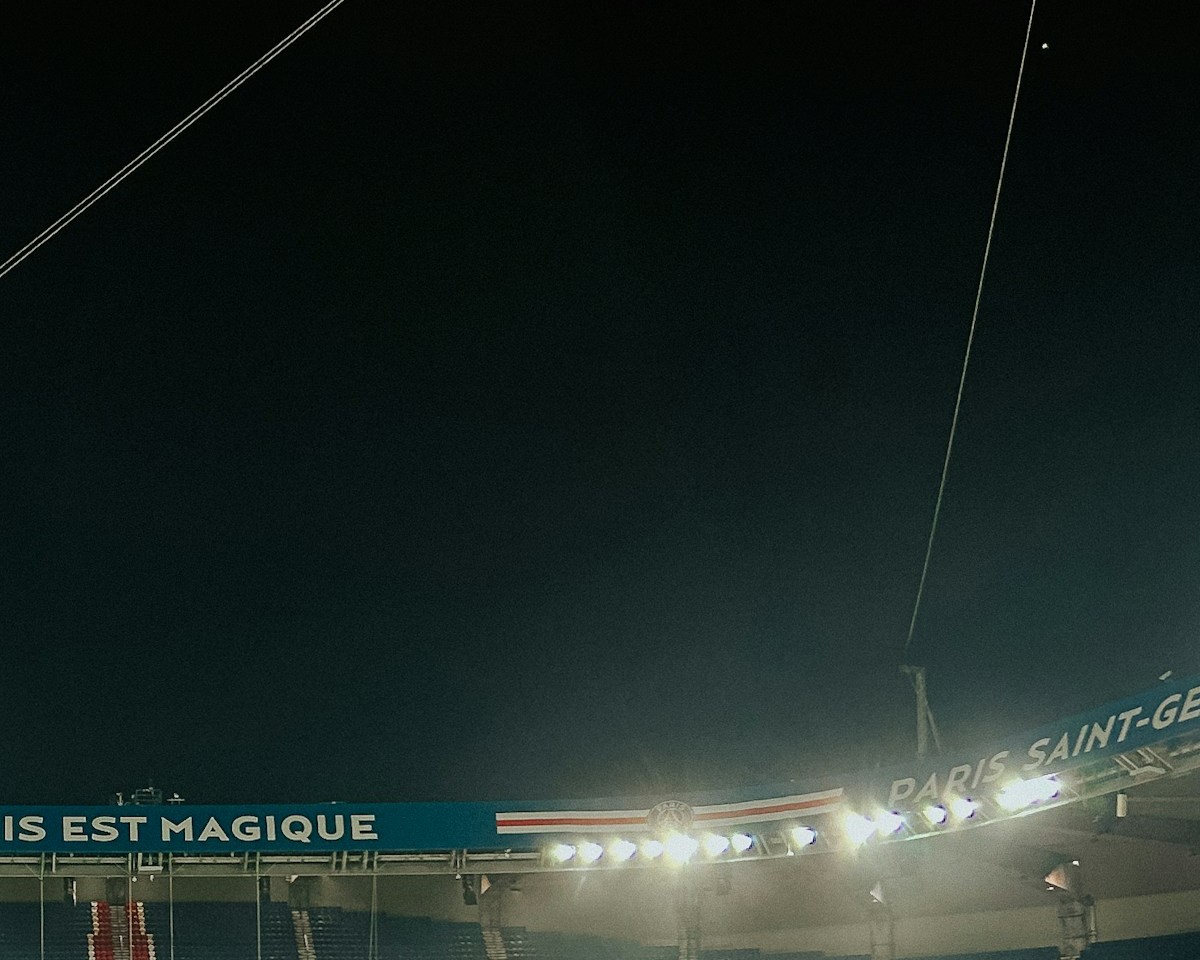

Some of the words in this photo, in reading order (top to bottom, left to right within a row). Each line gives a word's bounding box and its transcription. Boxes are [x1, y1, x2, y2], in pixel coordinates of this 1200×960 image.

[888, 751, 1010, 807] PARIS
[1023, 685, 1200, 771] SAINT-GE
[63, 814, 147, 842] EST
[161, 814, 379, 843] MAGIQUE
